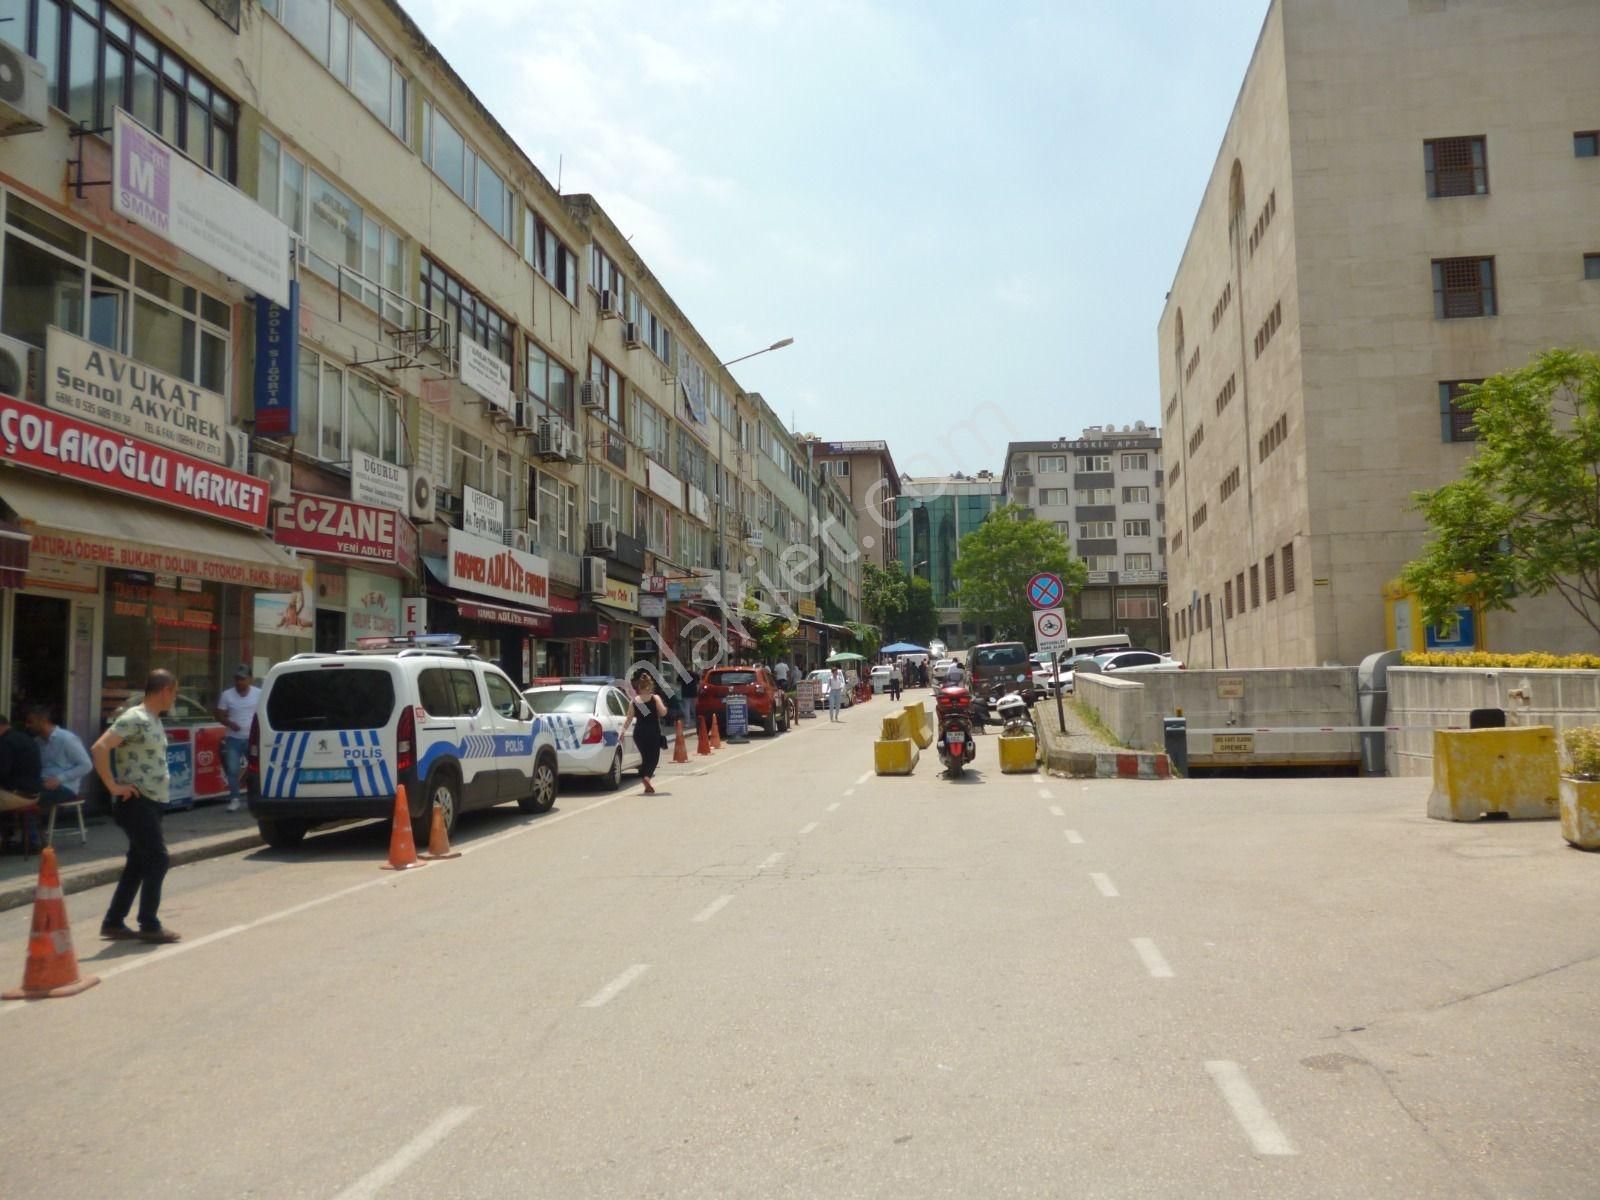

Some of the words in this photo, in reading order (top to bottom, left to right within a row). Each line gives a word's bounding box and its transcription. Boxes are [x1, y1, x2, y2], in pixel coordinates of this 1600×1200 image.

[121, 191, 169, 233] SMMM
[85, 350, 201, 412] AVUKAT
[56, 366, 122, 405] Şenol
[130, 395, 220, 441] AKYÜREK
[1, 408, 168, 488] ÇOLAKOĞLU
[175, 463, 264, 514] MARKET
[277, 498, 393, 545] ECZANE
[32, 535, 73, 557] ATURA
[337, 541, 359, 554] YENİ
[361, 543, 392, 558] ADLİYE
[487, 549, 524, 593] ADLİYE
[343, 747, 382, 759] POLİS
[505, 738, 524, 753] POLİS
